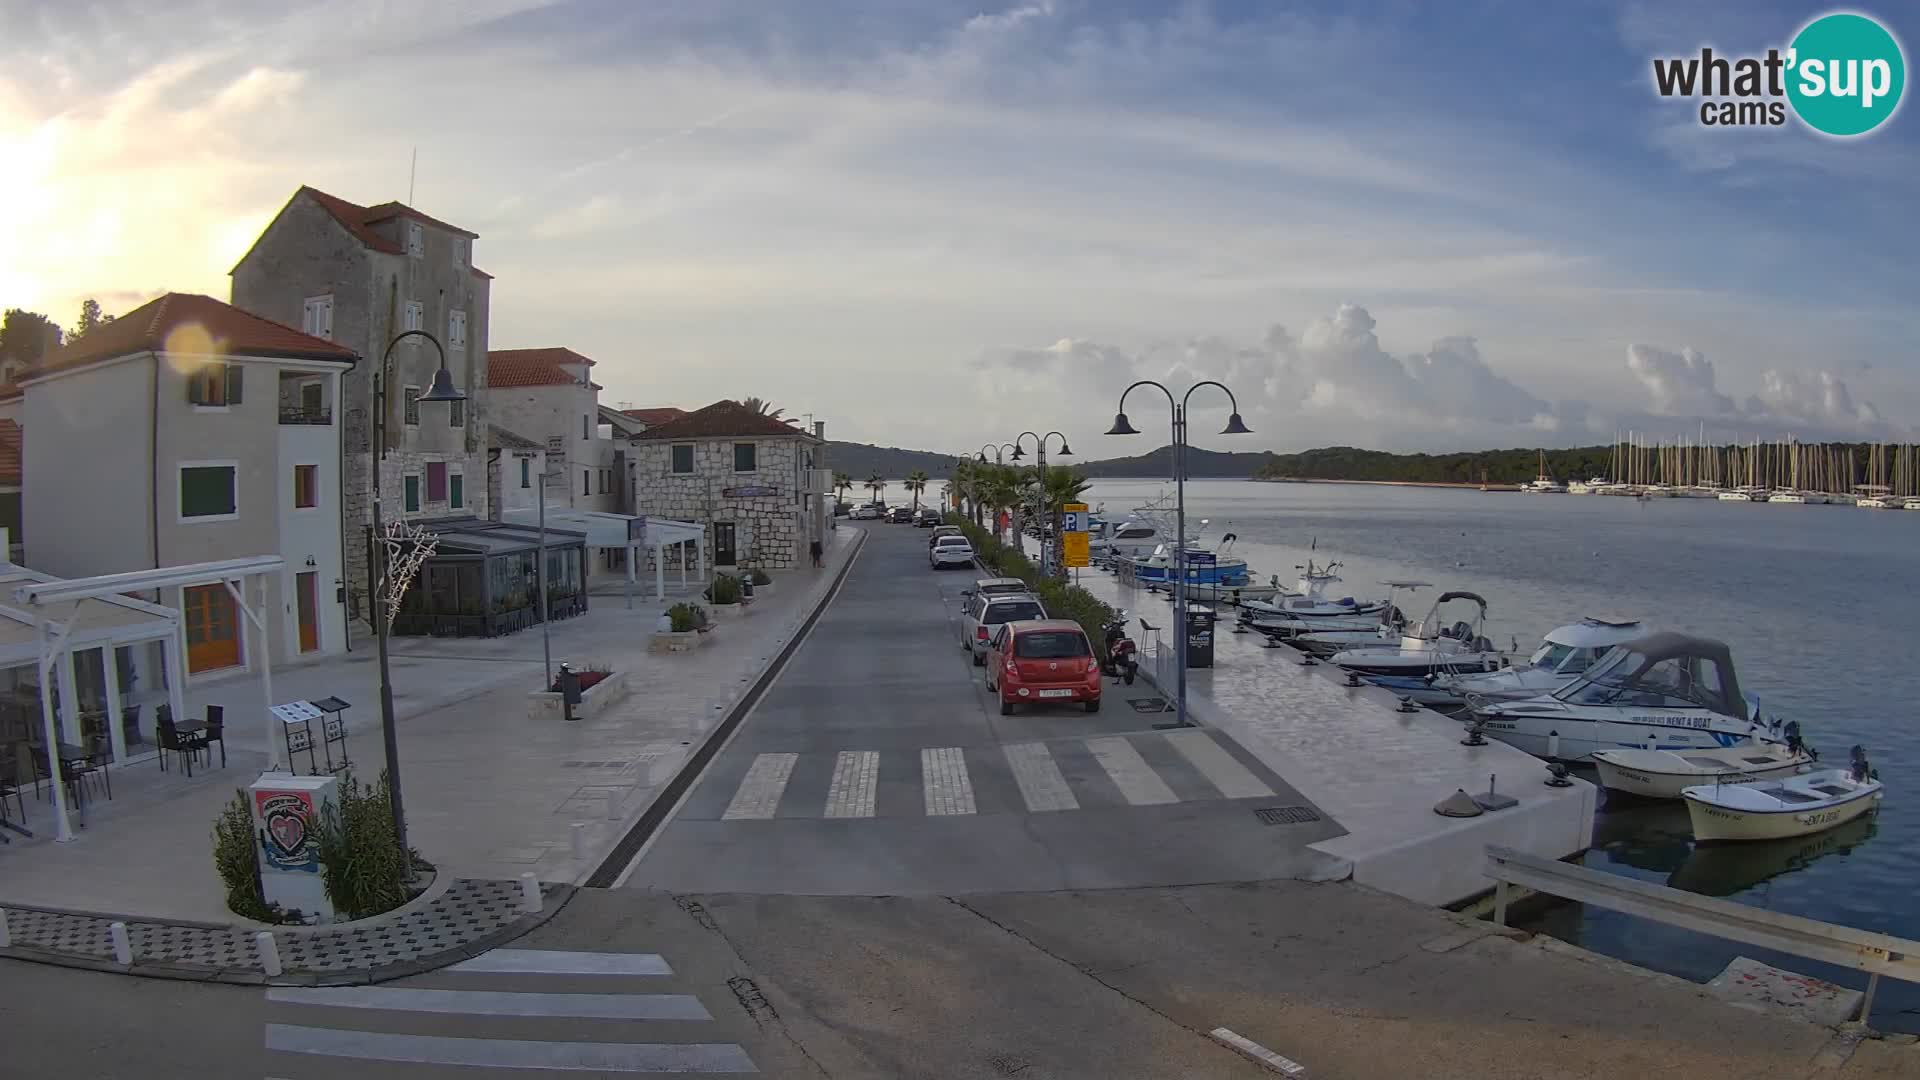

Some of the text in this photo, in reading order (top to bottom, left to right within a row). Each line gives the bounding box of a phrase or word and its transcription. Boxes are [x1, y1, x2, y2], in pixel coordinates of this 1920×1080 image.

[1065, 513, 1076, 530] P
[1666, 716, 1686, 726] RENT
[1686, 717, 1692, 727] A
[1693, 717, 1713, 729] BOAT
